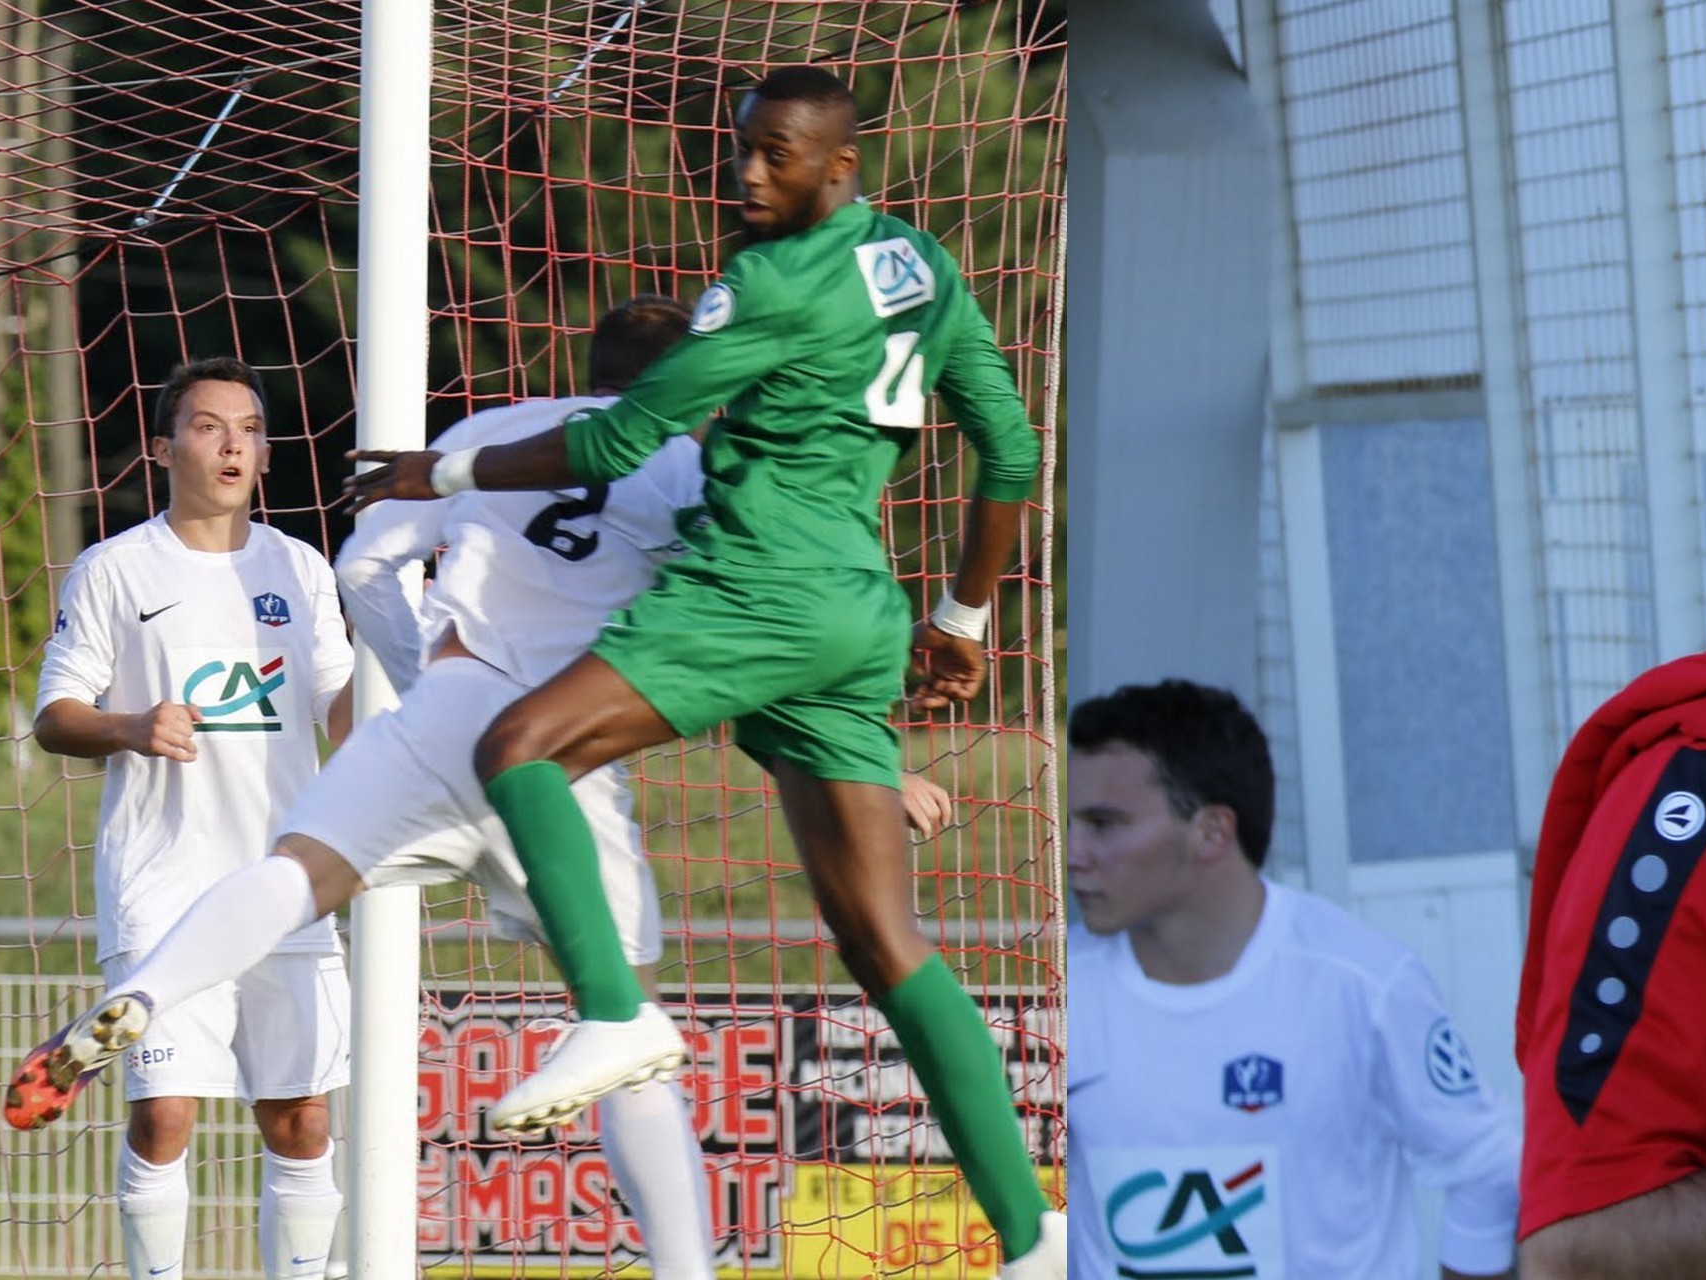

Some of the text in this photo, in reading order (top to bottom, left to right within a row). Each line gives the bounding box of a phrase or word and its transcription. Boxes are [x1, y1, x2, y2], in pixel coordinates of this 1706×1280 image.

[865, 330, 926, 429] 4
[183, 656, 285, 718] CA
[458, 1153, 773, 1250] MAST
[1106, 1161, 1265, 1260] CA
